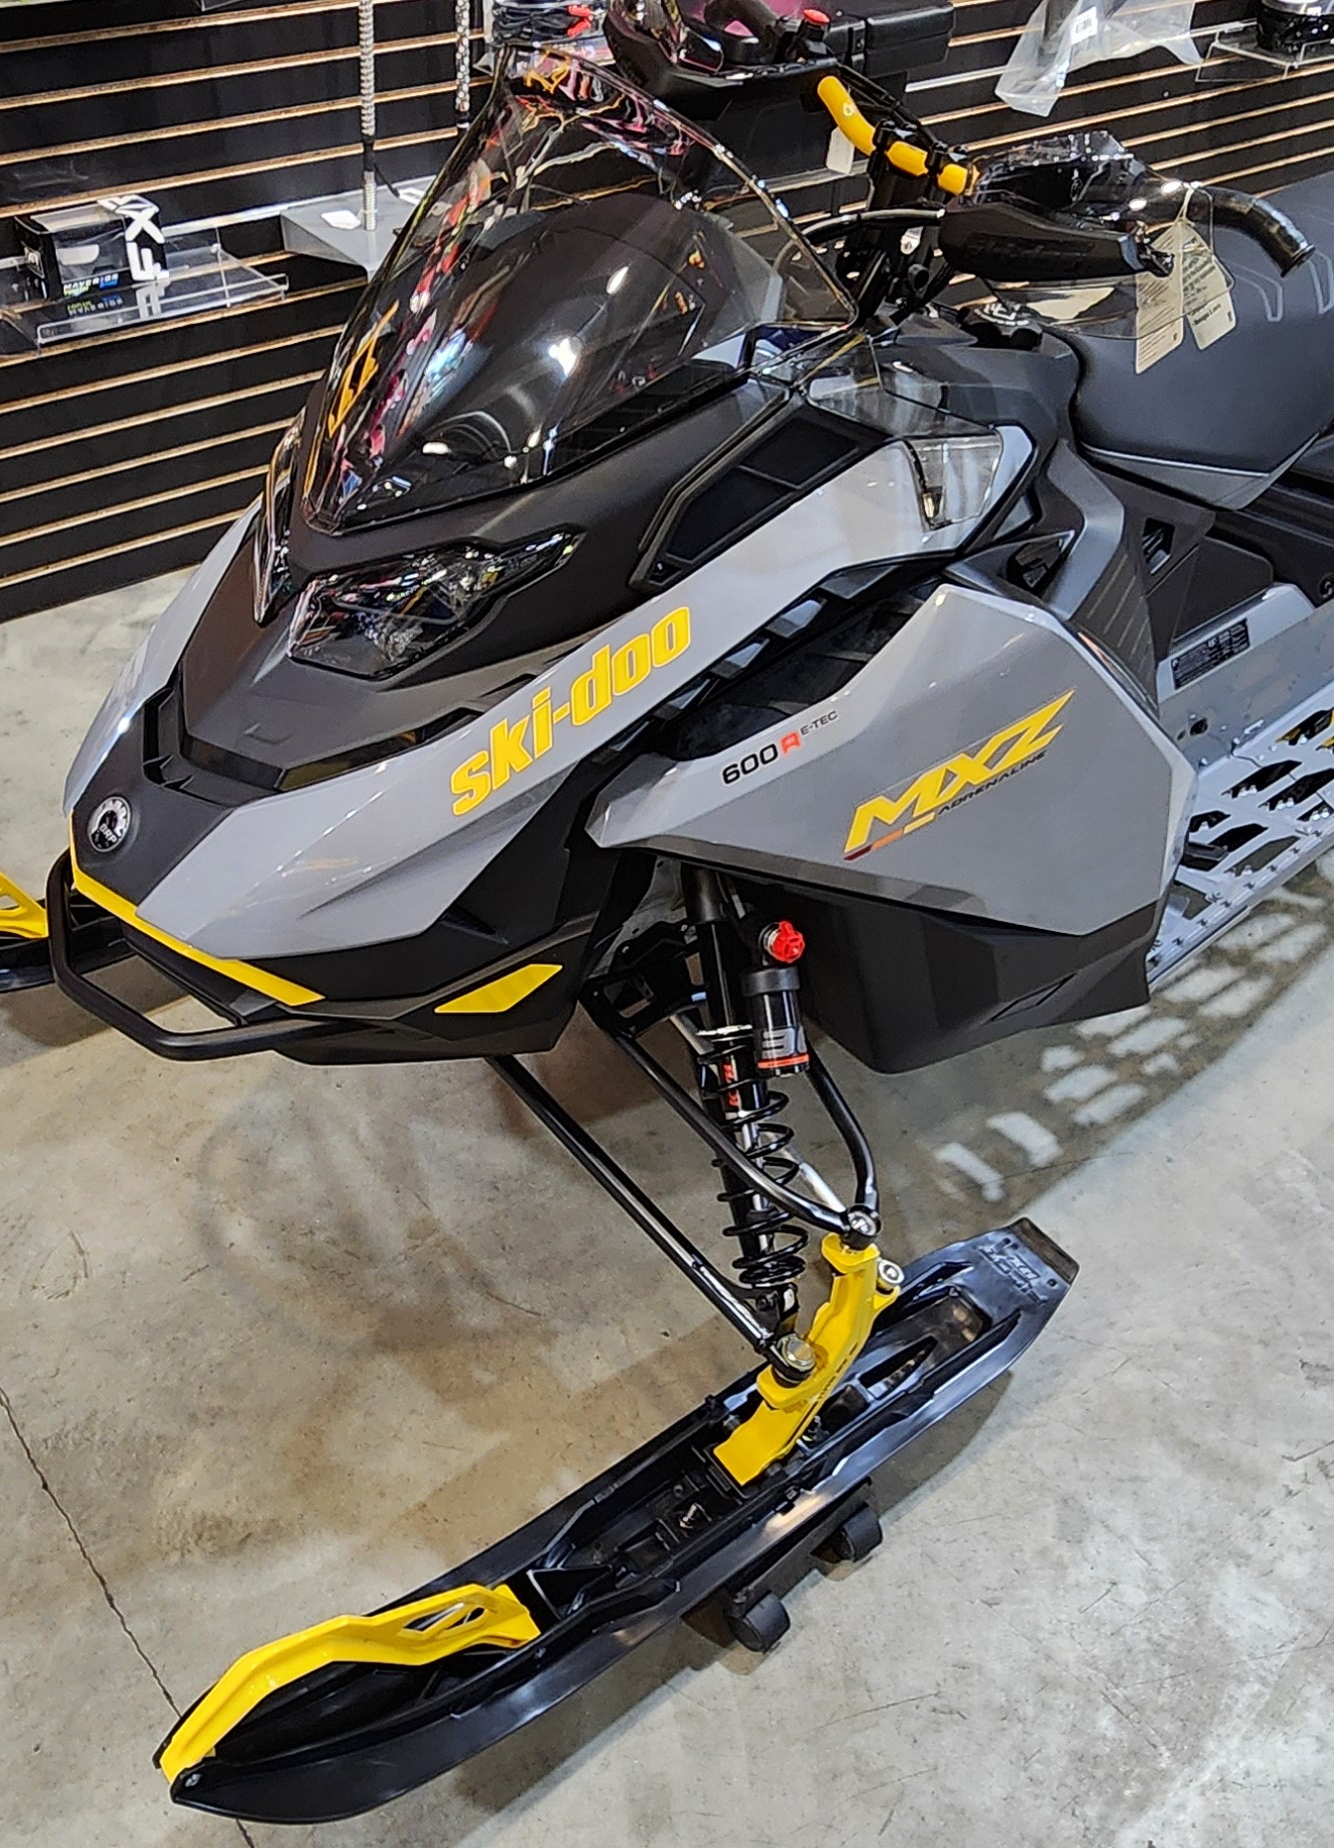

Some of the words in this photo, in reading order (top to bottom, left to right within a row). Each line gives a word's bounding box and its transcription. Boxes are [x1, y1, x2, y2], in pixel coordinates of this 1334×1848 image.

[450, 606, 691, 817] ski-doo
[800, 710, 839, 736] E-TEC
[844, 686, 1077, 855] MXZ
[938, 750, 1048, 816] ADRENALINE
